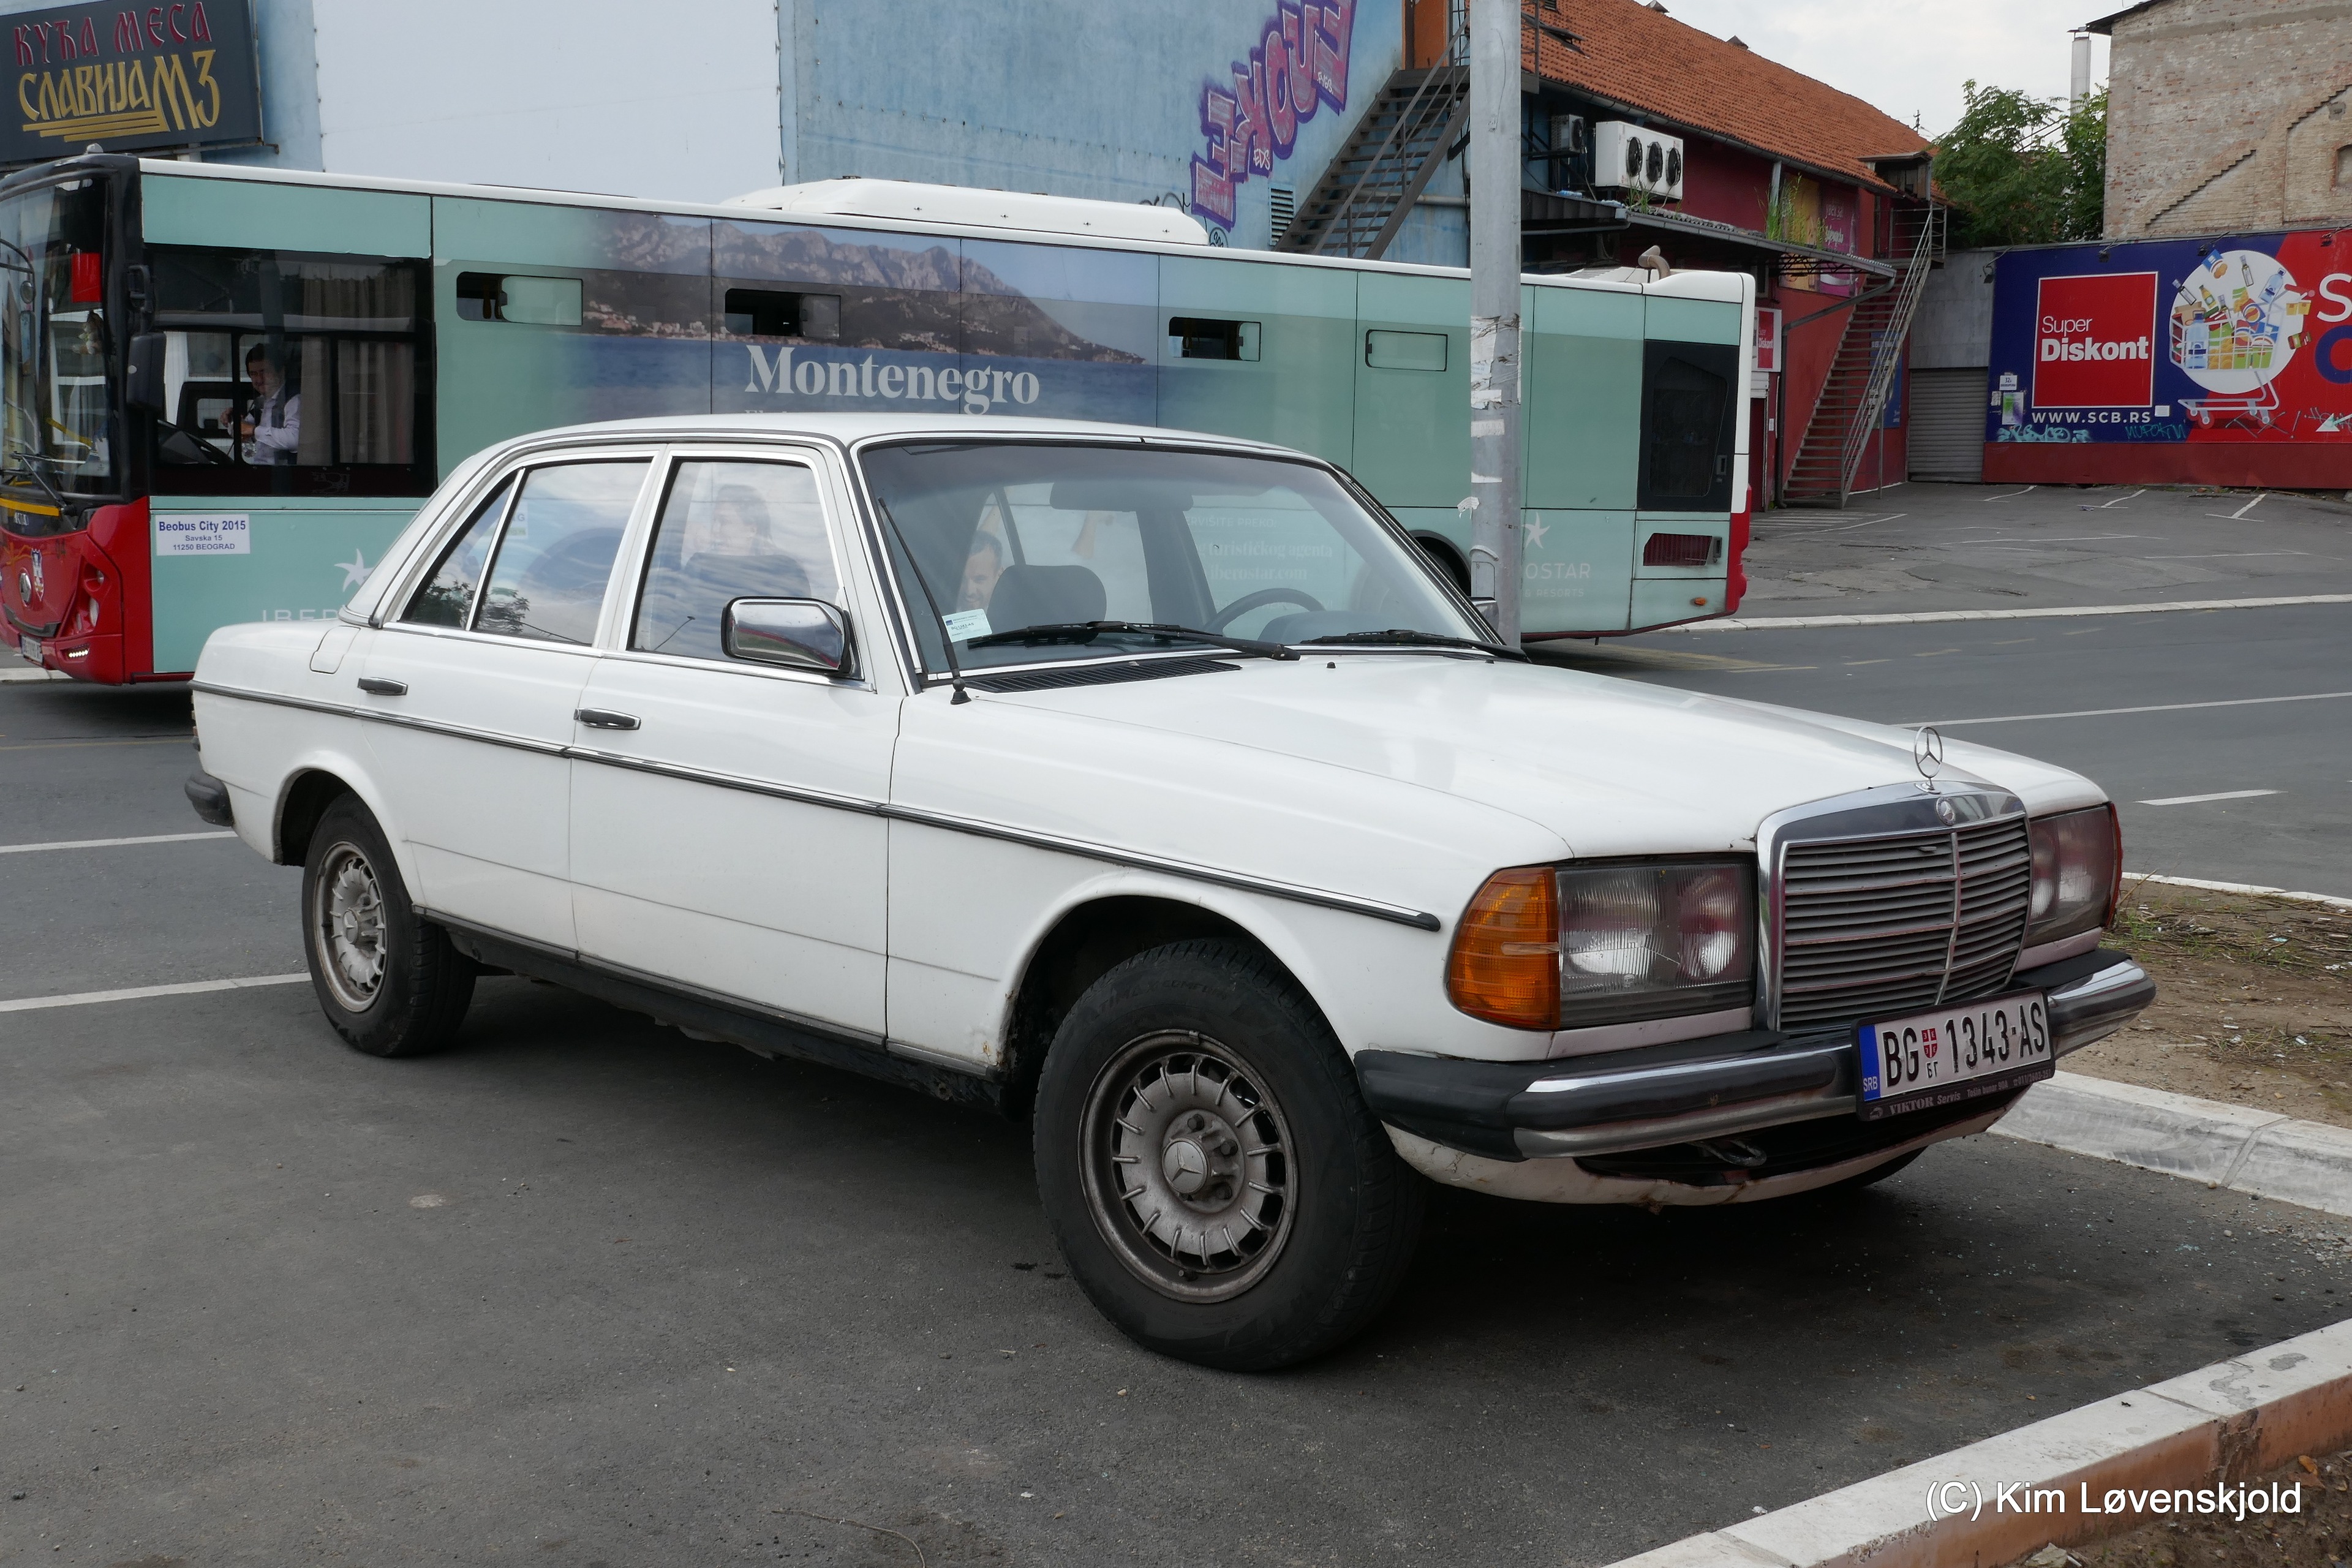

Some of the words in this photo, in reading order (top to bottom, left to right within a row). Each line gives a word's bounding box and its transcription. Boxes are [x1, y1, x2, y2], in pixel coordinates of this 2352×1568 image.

[14, 17, 100, 67] КУЋА
[113, 1, 213, 53] МЕСА
[2041, 315, 2092, 337] Super
[2041, 336, 2149, 362] Diskont
[744, 344, 1041, 415] Montenegro
[2032, 412, 2151, 423] WWW.SCB.RS
[159, 521, 196, 531] Beobus
[199, 521, 219, 533] City
[222, 521, 246, 530] 2015
[1288, 546, 1332, 559] agenta
[1210, 565, 1308, 581] iberostar.com
[1536, 589, 1584, 597] RESORTS
[1882, 1027, 1920, 1087] BG
[1926, 1061, 1939, 1079] БГ
[1863, 1076, 1878, 1092] SRB
[1890, 1096, 1934, 1115] VIKTOR
[1937, 1091, 1961, 1105] Servis
